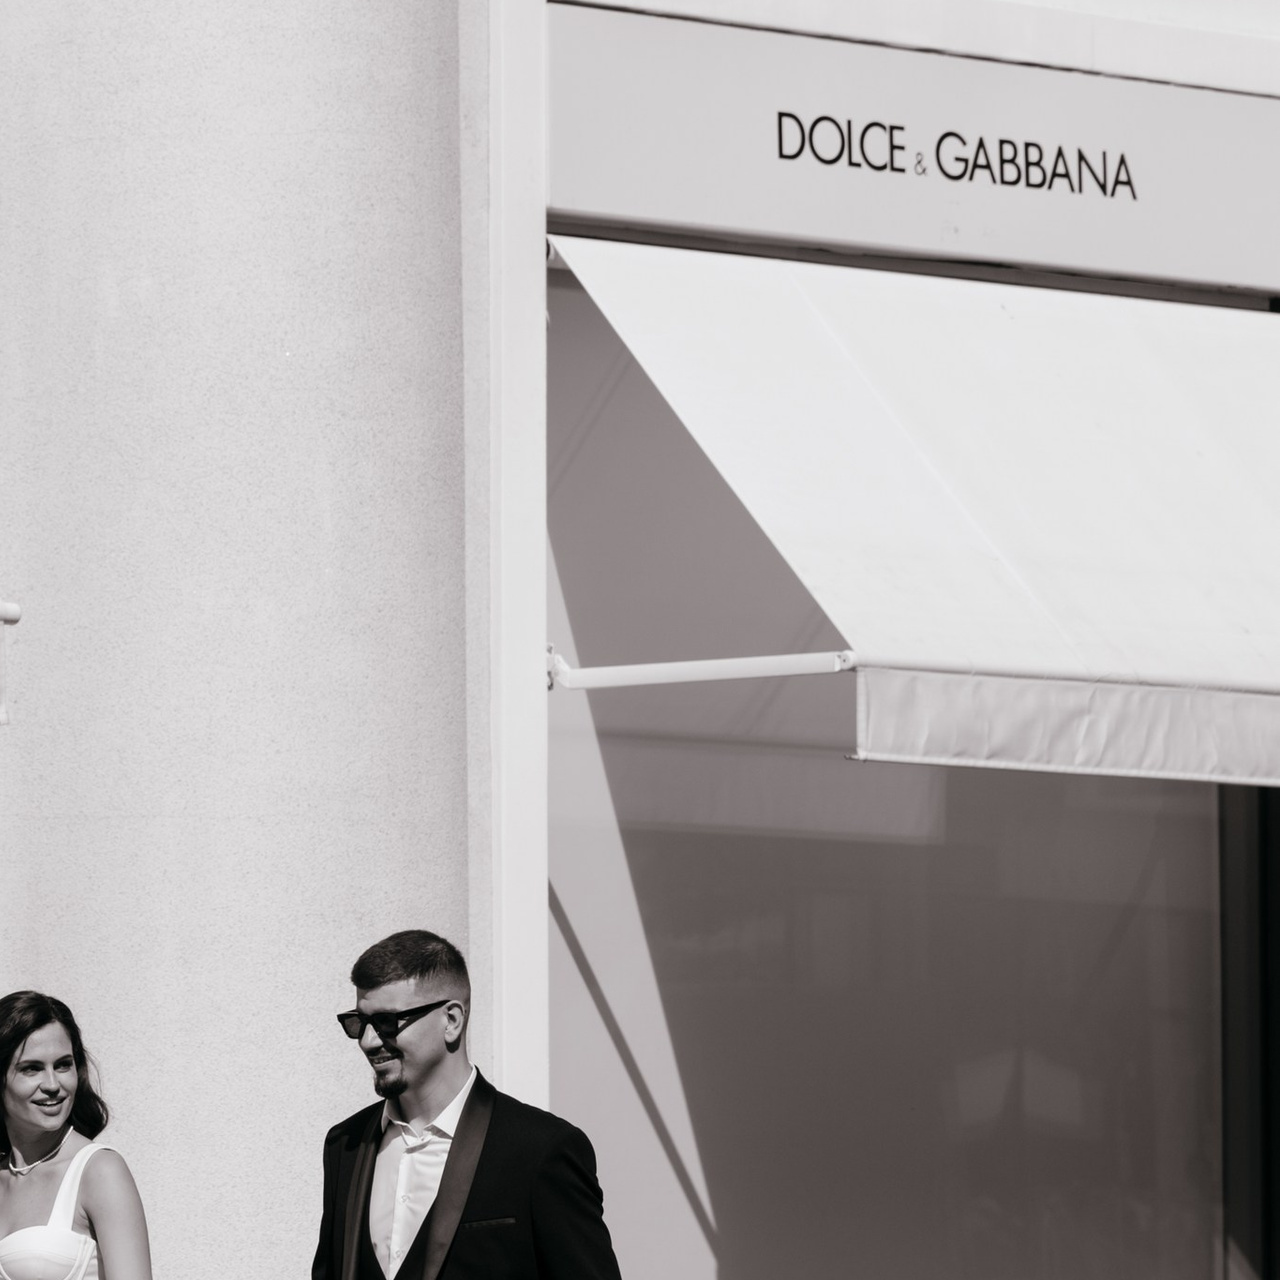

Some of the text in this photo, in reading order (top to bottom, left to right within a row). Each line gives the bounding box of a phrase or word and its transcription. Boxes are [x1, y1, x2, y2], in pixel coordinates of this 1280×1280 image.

[776, 111, 1138, 201] DOLCE & GABBANA
